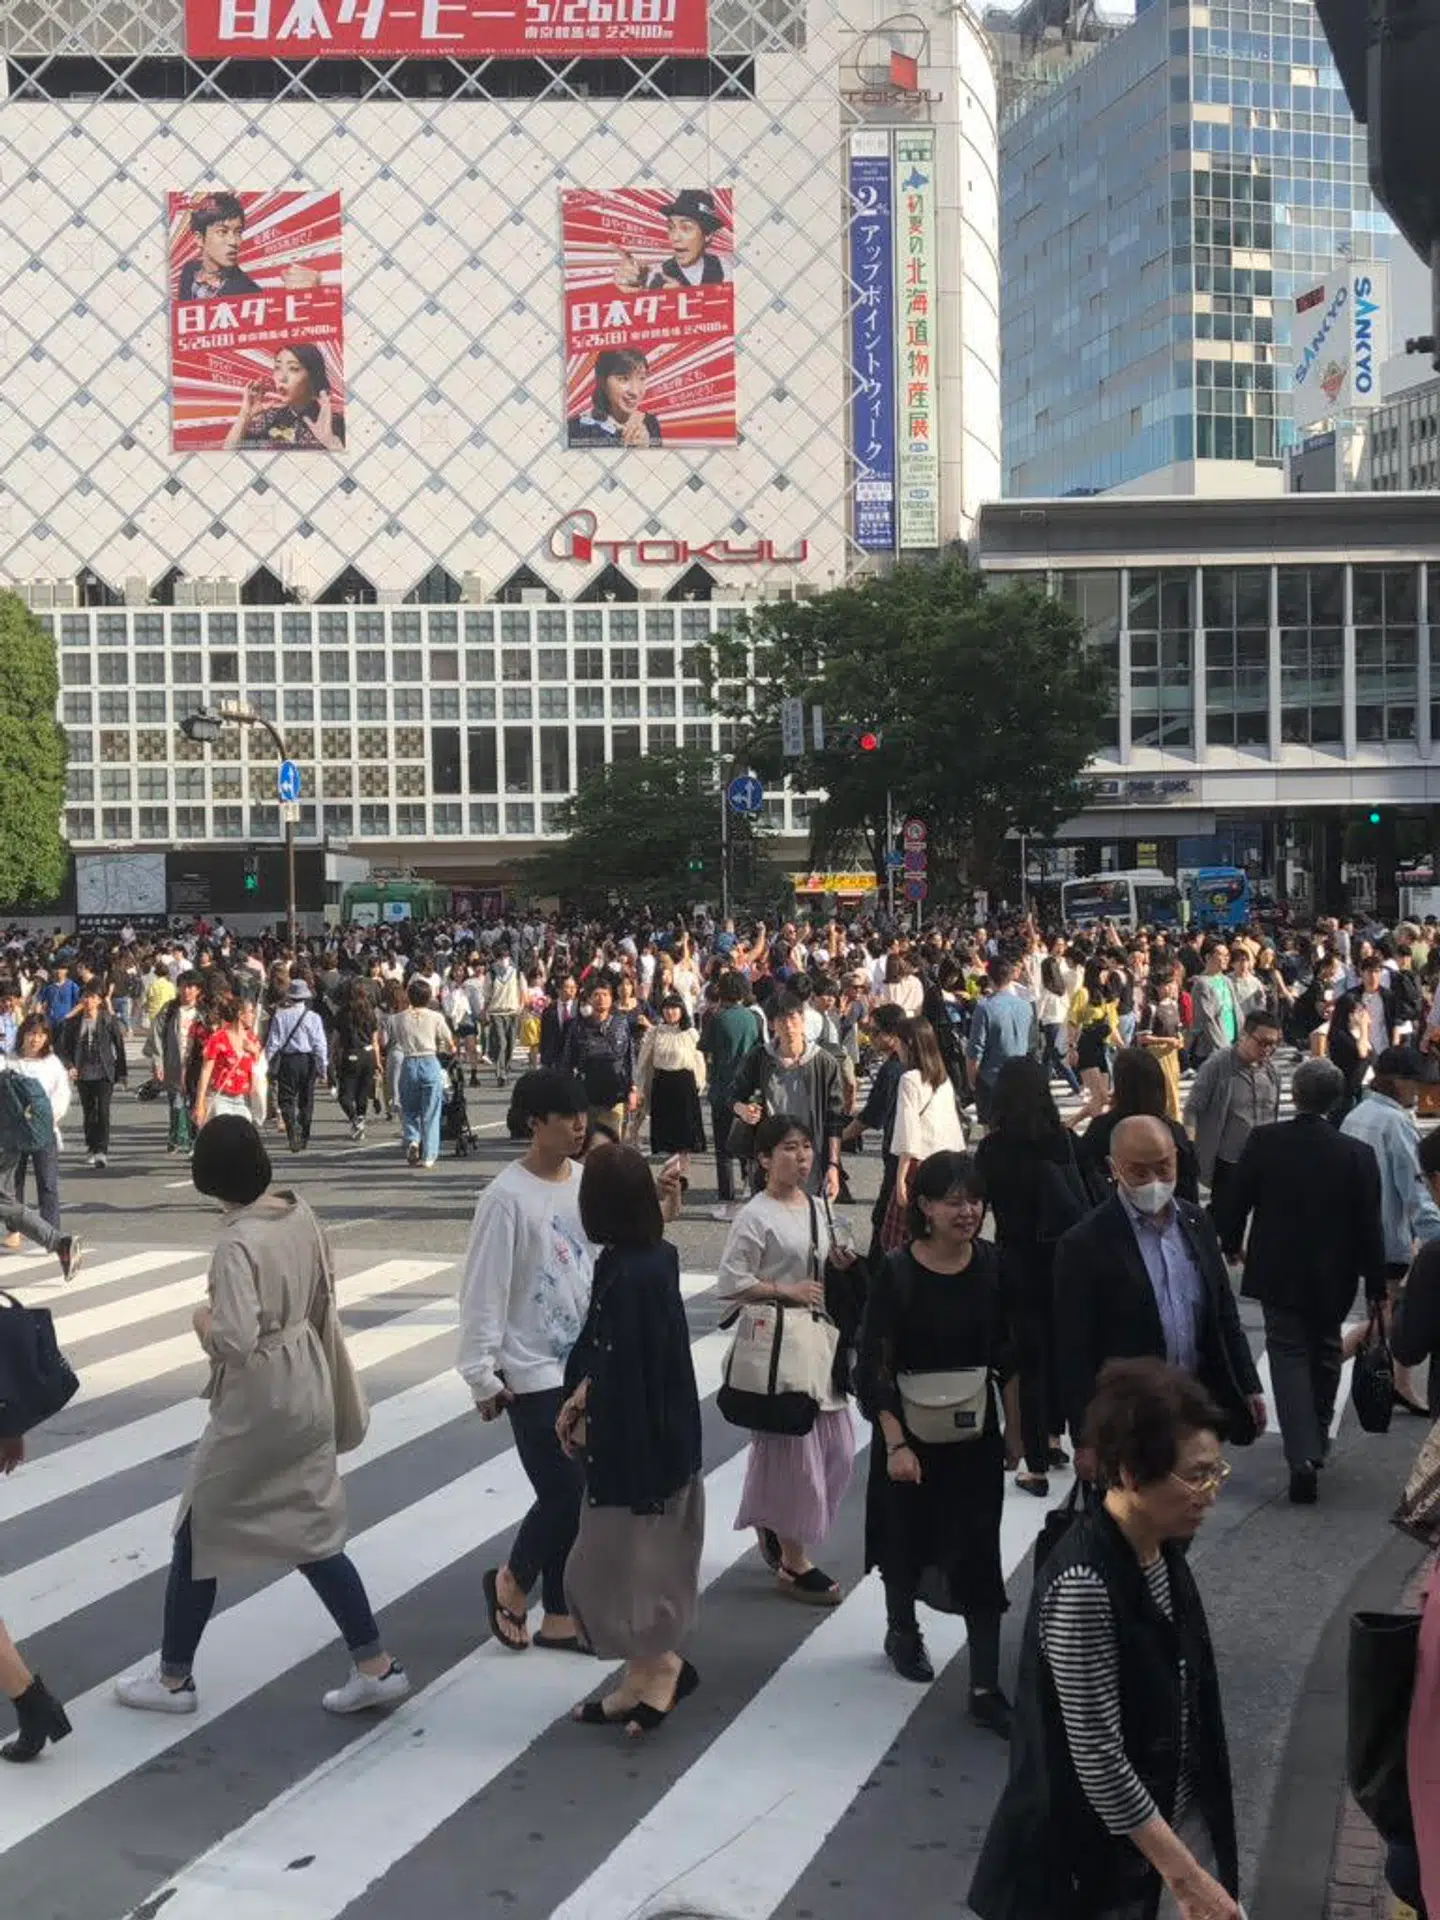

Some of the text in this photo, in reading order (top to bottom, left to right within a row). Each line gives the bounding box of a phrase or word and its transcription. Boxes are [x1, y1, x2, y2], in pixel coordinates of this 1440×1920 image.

[841, 91, 943, 102] TOKYU
[177, 294, 337, 335] 日本ダービー
[571, 291, 729, 331] 日本ダービー
[860, 224, 883, 461] アップポイントウィーク
[905, 194, 930, 440] 初夏の北海道物産展
[1295, 286, 1348, 385] SANKYO
[1354, 276, 1381, 394] SANKYO
[594, 540, 807, 564] TOKYU
